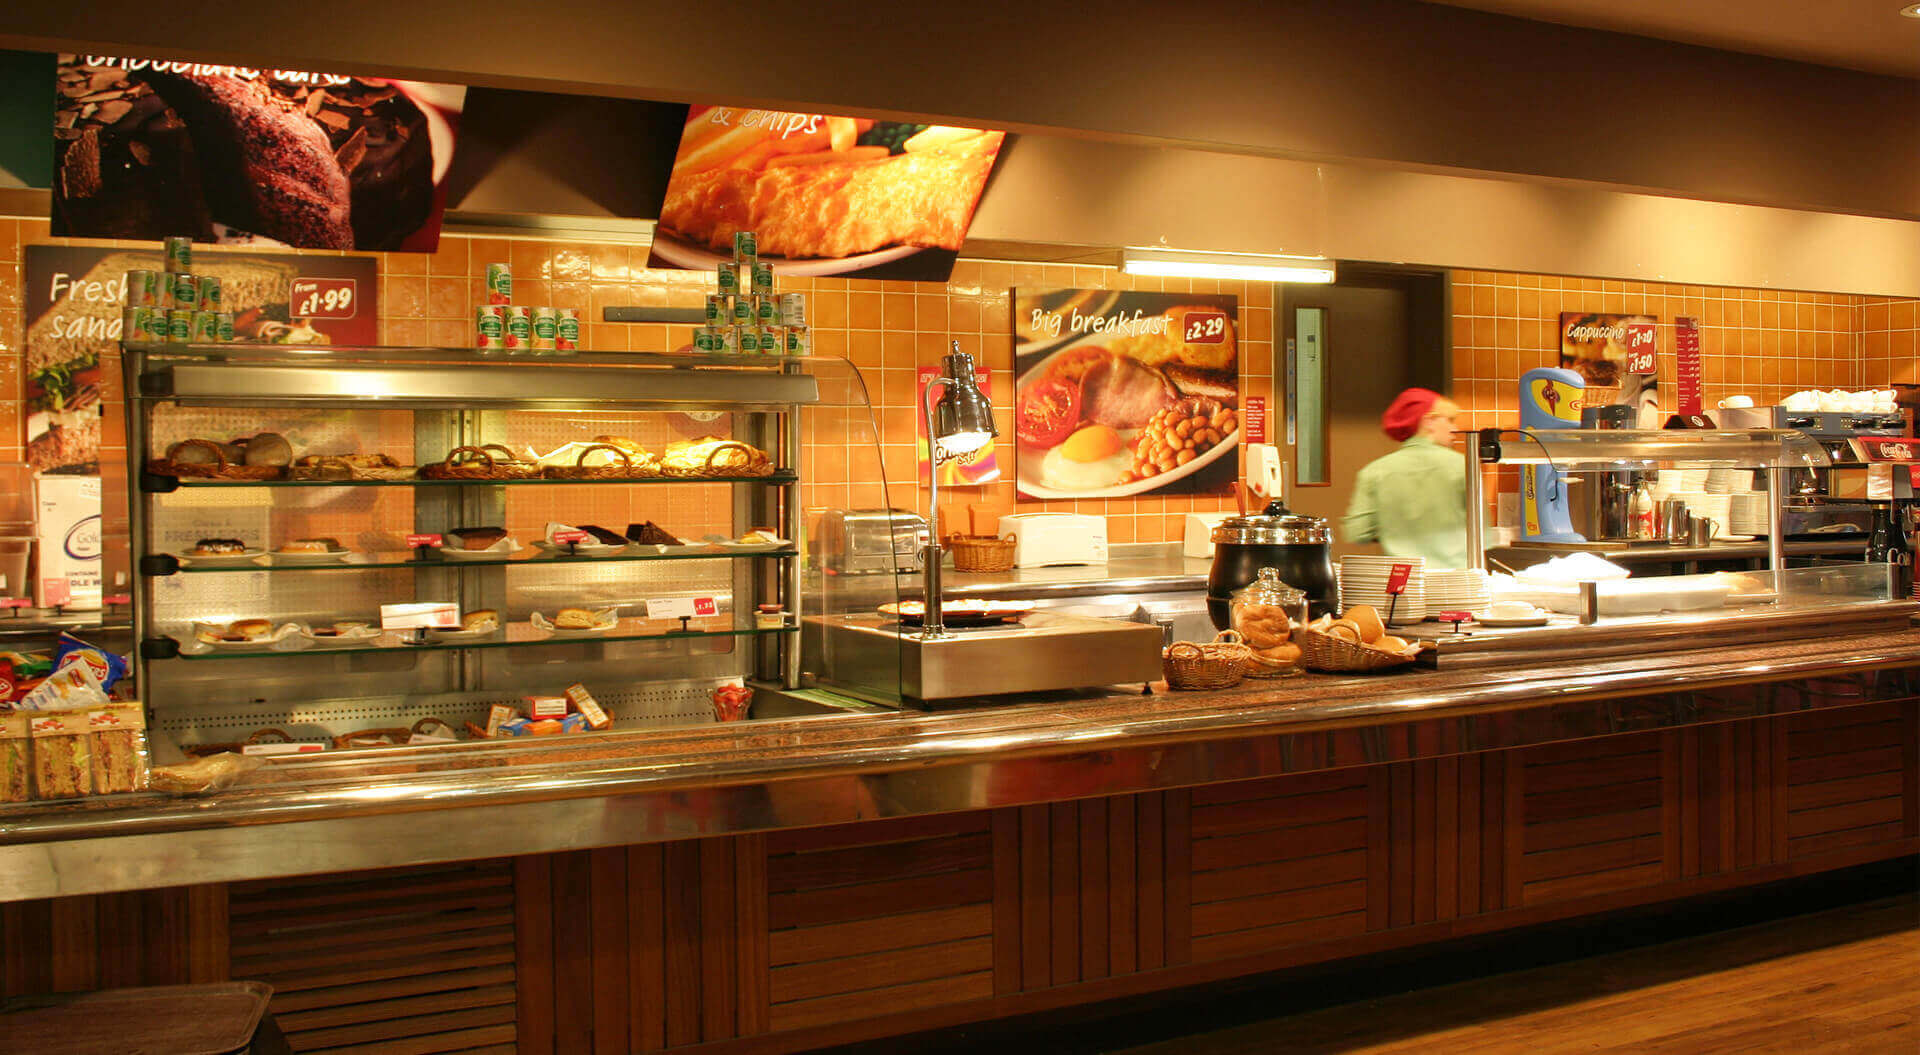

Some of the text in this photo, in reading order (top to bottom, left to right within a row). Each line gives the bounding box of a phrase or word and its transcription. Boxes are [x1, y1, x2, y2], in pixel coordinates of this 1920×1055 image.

[711, 107, 731, 126] &
[1031, 307, 1174, 337] Big breakfast
[1567, 323, 1625, 342] Cappuccino
